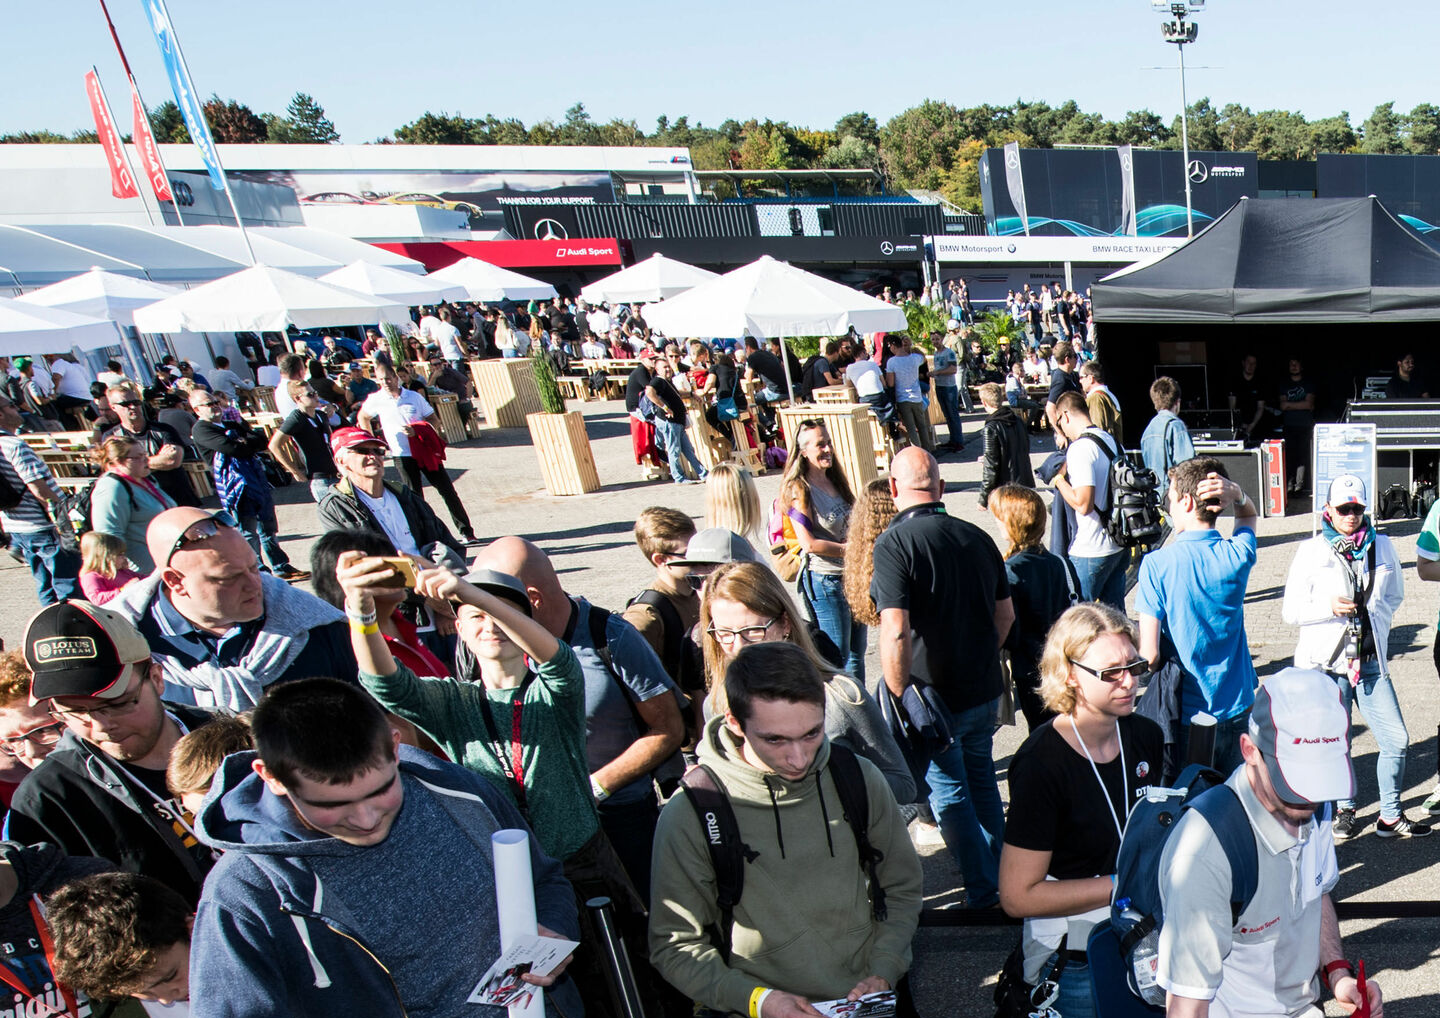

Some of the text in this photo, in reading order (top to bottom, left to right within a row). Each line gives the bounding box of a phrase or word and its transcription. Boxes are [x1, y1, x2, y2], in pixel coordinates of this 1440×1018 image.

[567, 247, 613, 257] Audi Sport
[961, 244, 1003, 254] Motorsport
[1093, 245, 1112, 253] BMW
[1113, 245, 1133, 253] RACE
[1135, 245, 1152, 253] TAXI
[52, 641, 90, 649] LOTUS
[1321, 736, 1340, 744] Sport
[705, 812, 722, 844] NITRO
[1249, 916, 1280, 933] Audi Sport
